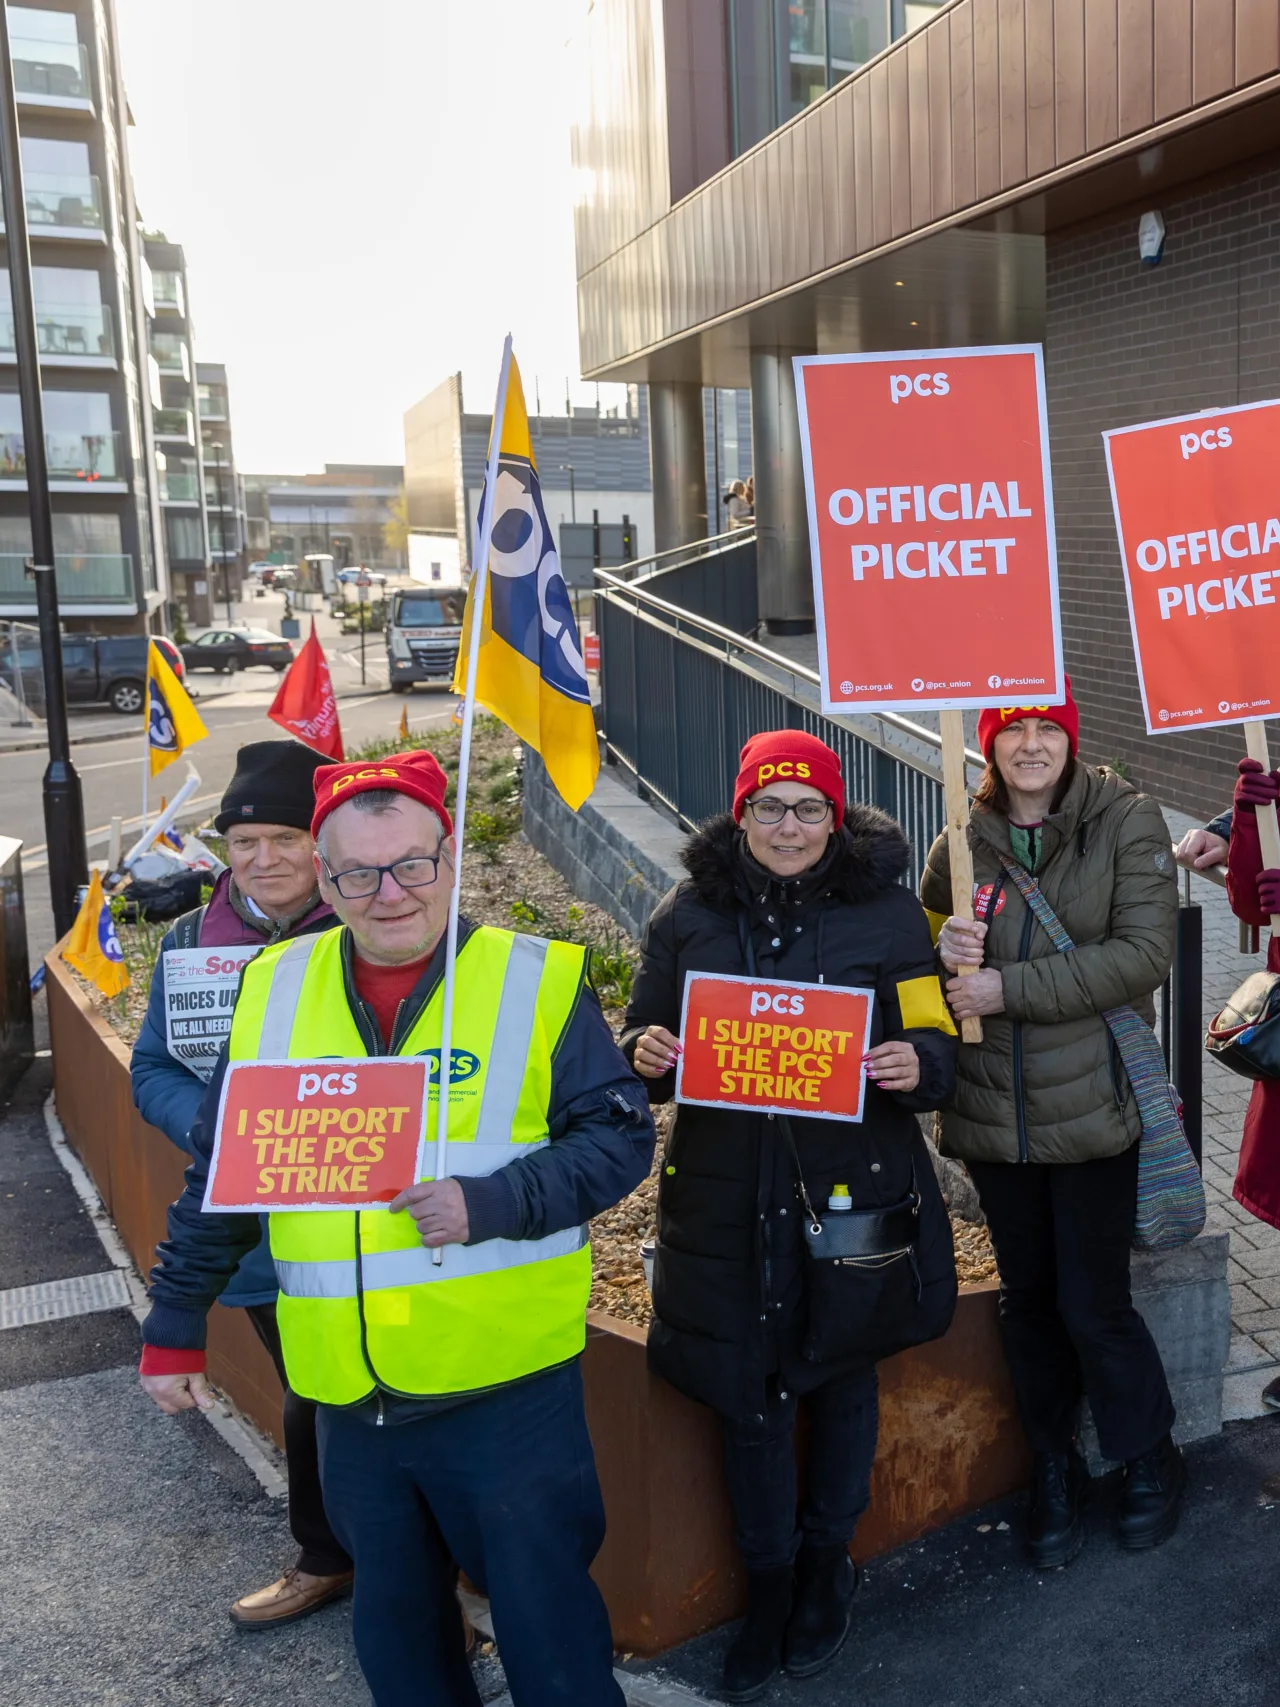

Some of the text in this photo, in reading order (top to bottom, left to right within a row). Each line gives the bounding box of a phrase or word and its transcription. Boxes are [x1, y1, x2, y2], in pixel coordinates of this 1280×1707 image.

[889, 372, 950, 404] pcs
[1180, 426, 1232, 460] pcs
[828, 481, 1032, 526] OFFICIAL
[850, 538, 1016, 581] PICKET
[855, 677, 1045, 693] pcs.org.uk @pcs_union @PcsUnion
[1170, 708, 1204, 719] pcs.org.uk
[1231, 698, 1270, 711] @pcs_union
[332, 768, 399, 796] pcs
[758, 762, 810, 787] pcs
[168, 990, 215, 1012] PRICES
[750, 990, 804, 1016] pcs
[172, 1018, 230, 1036] WE ALL NEED
[698, 1017, 854, 1054] I SUPPORT
[172, 1041, 220, 1059] TORIES
[712, 1044, 832, 1078] THE PCS
[297, 1072, 358, 1102] pcs
[719, 1070, 821, 1102] STRIKE
[236, 1106, 410, 1136] I SUPPORT
[252, 1136, 386, 1165] THE PCS
[256, 1165, 370, 1194] STRIKE
